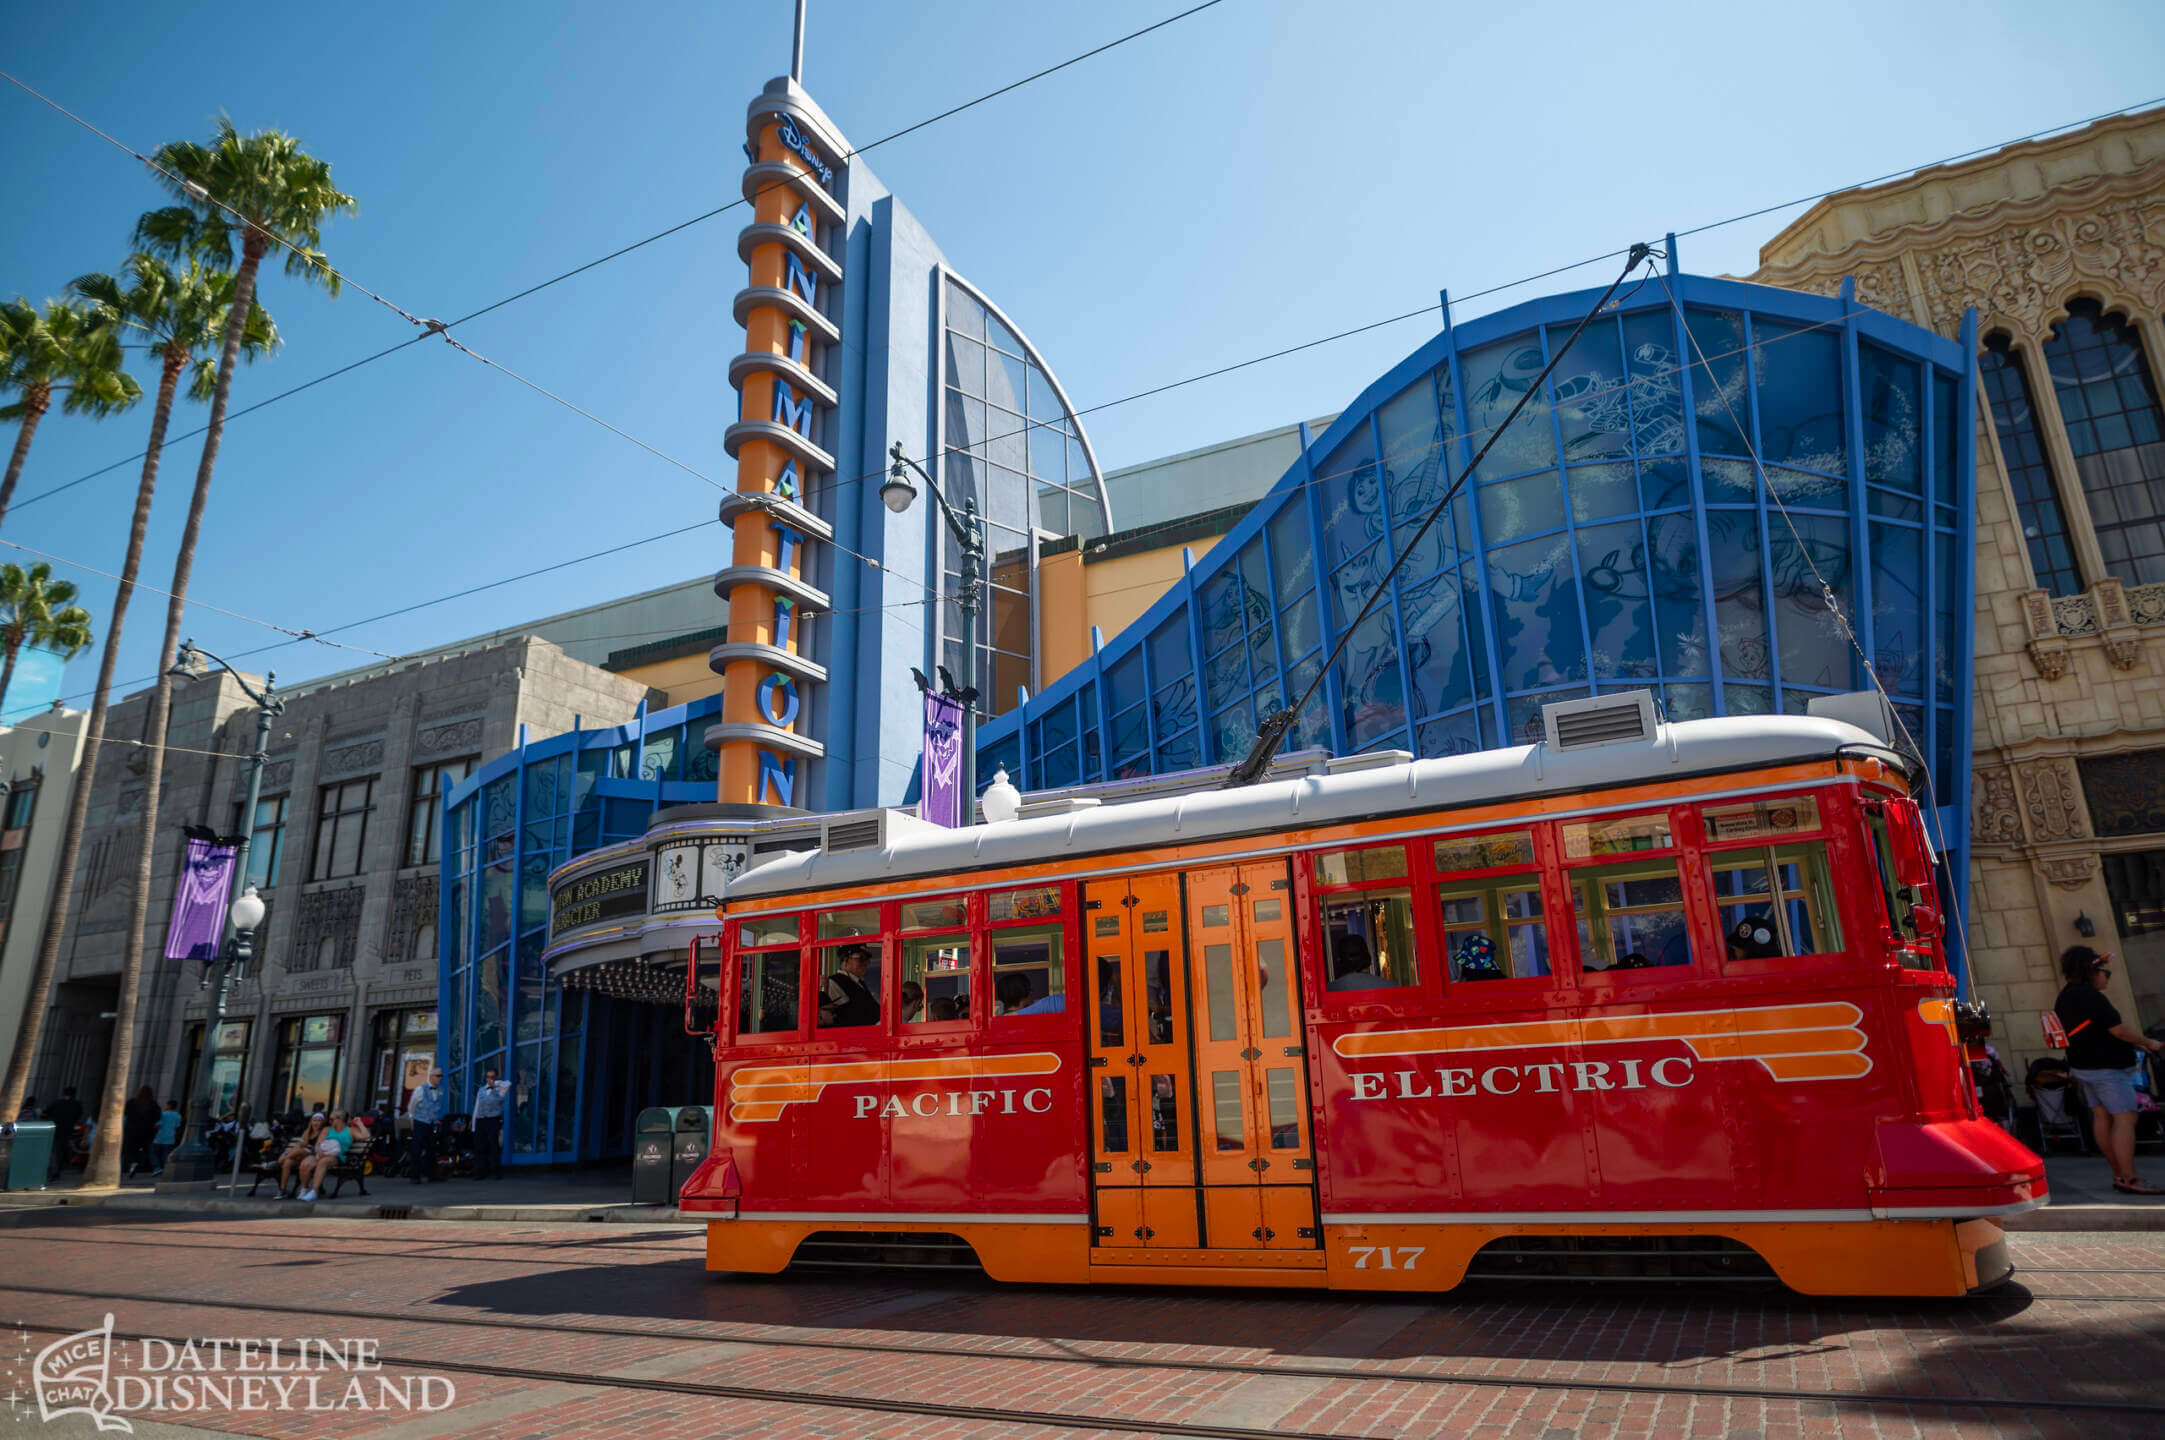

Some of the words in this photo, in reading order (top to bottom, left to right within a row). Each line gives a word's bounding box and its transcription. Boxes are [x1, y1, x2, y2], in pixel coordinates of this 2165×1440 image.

[775, 111, 833, 184] Disney
[576, 867, 642, 901] ACADEMY
[1347, 1056, 1696, 1101] ELECTRIC
[852, 1087, 1053, 1119] PACIFIC
[1348, 1246, 1426, 1270] 717
